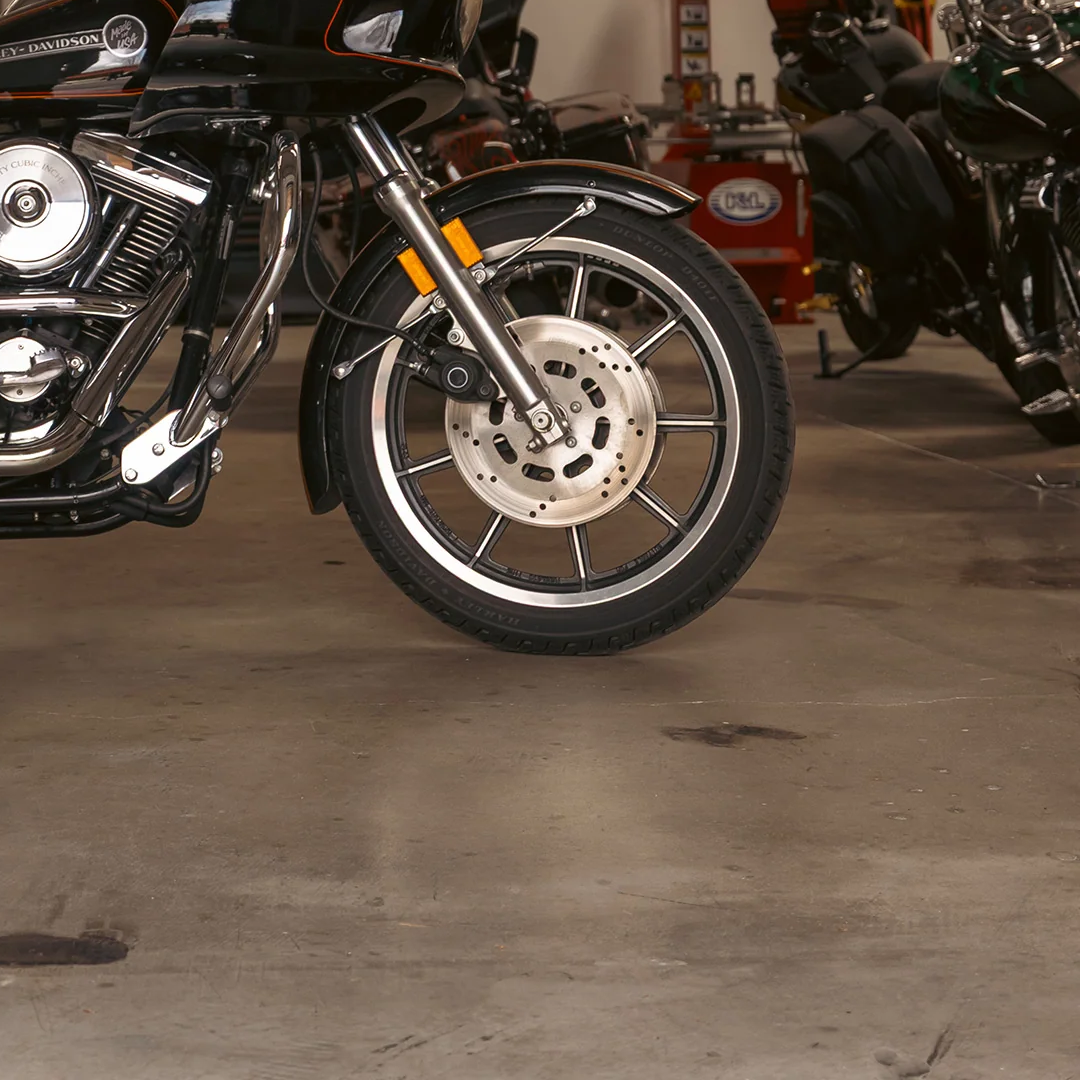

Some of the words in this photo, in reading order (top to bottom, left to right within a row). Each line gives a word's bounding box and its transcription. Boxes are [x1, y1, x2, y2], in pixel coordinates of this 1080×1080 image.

[111, 20, 131, 40] Made
[117, 33, 138, 48] USA
[11, 160, 40, 169] CUBIC
